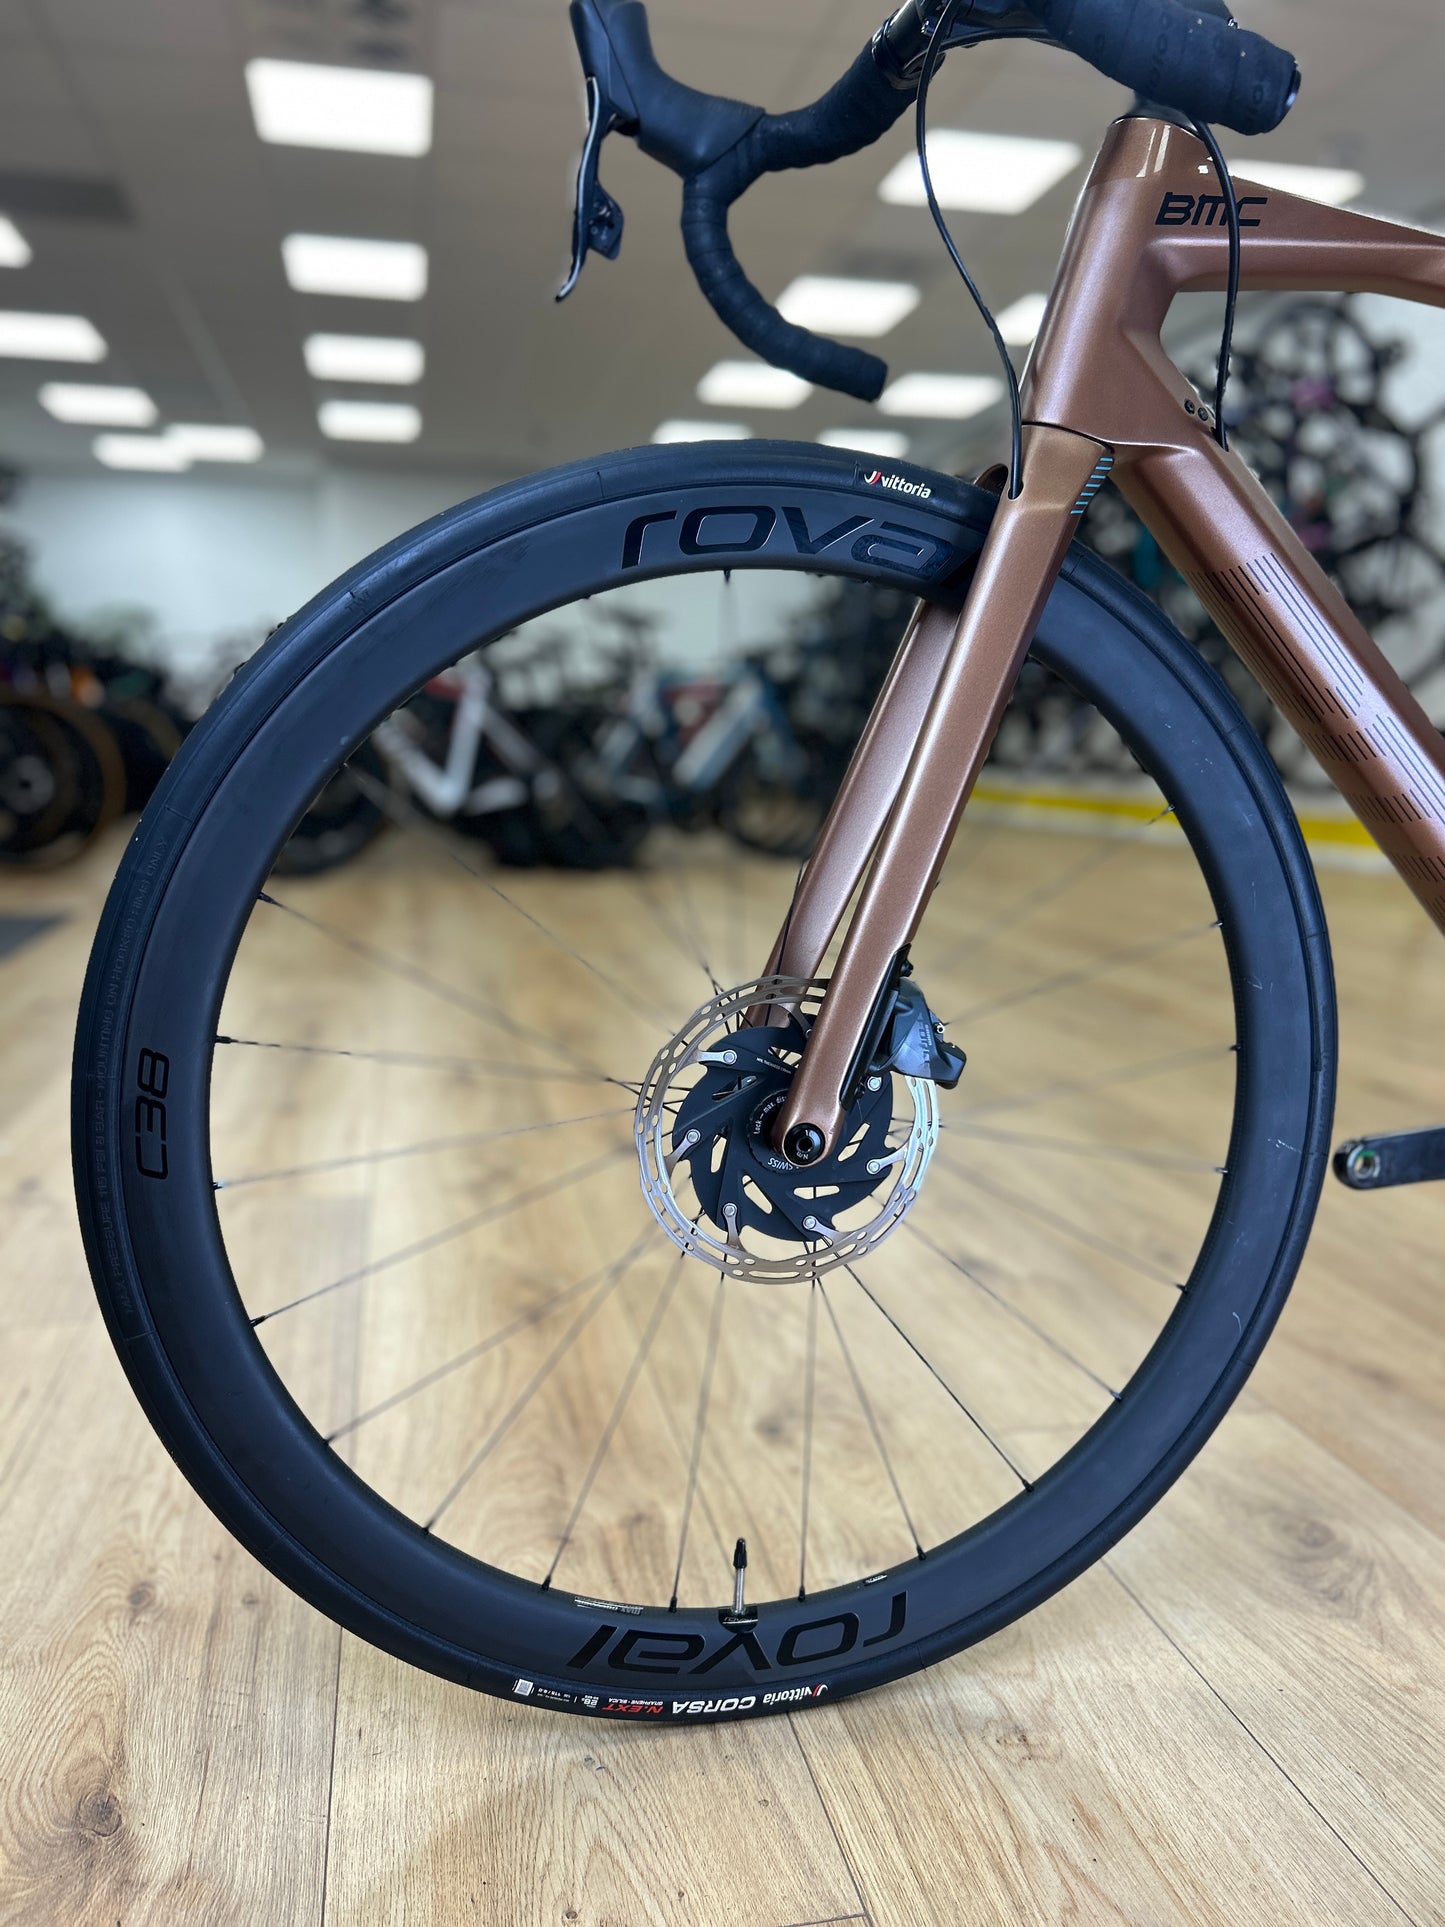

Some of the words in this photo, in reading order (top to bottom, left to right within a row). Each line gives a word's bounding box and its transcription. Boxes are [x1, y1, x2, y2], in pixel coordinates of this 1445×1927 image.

[1155, 192, 1268, 227] BMC
[880, 474, 932, 499] vittoria
[95, 1009, 115, 1090] MOUNTING
[95, 1099, 105, 1133] BAR
[135, 1047, 170, 1180] C38
[768, 1157, 794, 1171] SWISS
[100, 1200, 123, 1278] PRESSURE
[565, 1591, 908, 1675] roval
[602, 1704, 664, 1714] N.EXT
[672, 1696, 756, 1714] CORSA
[763, 1686, 814, 1706] vittoria
